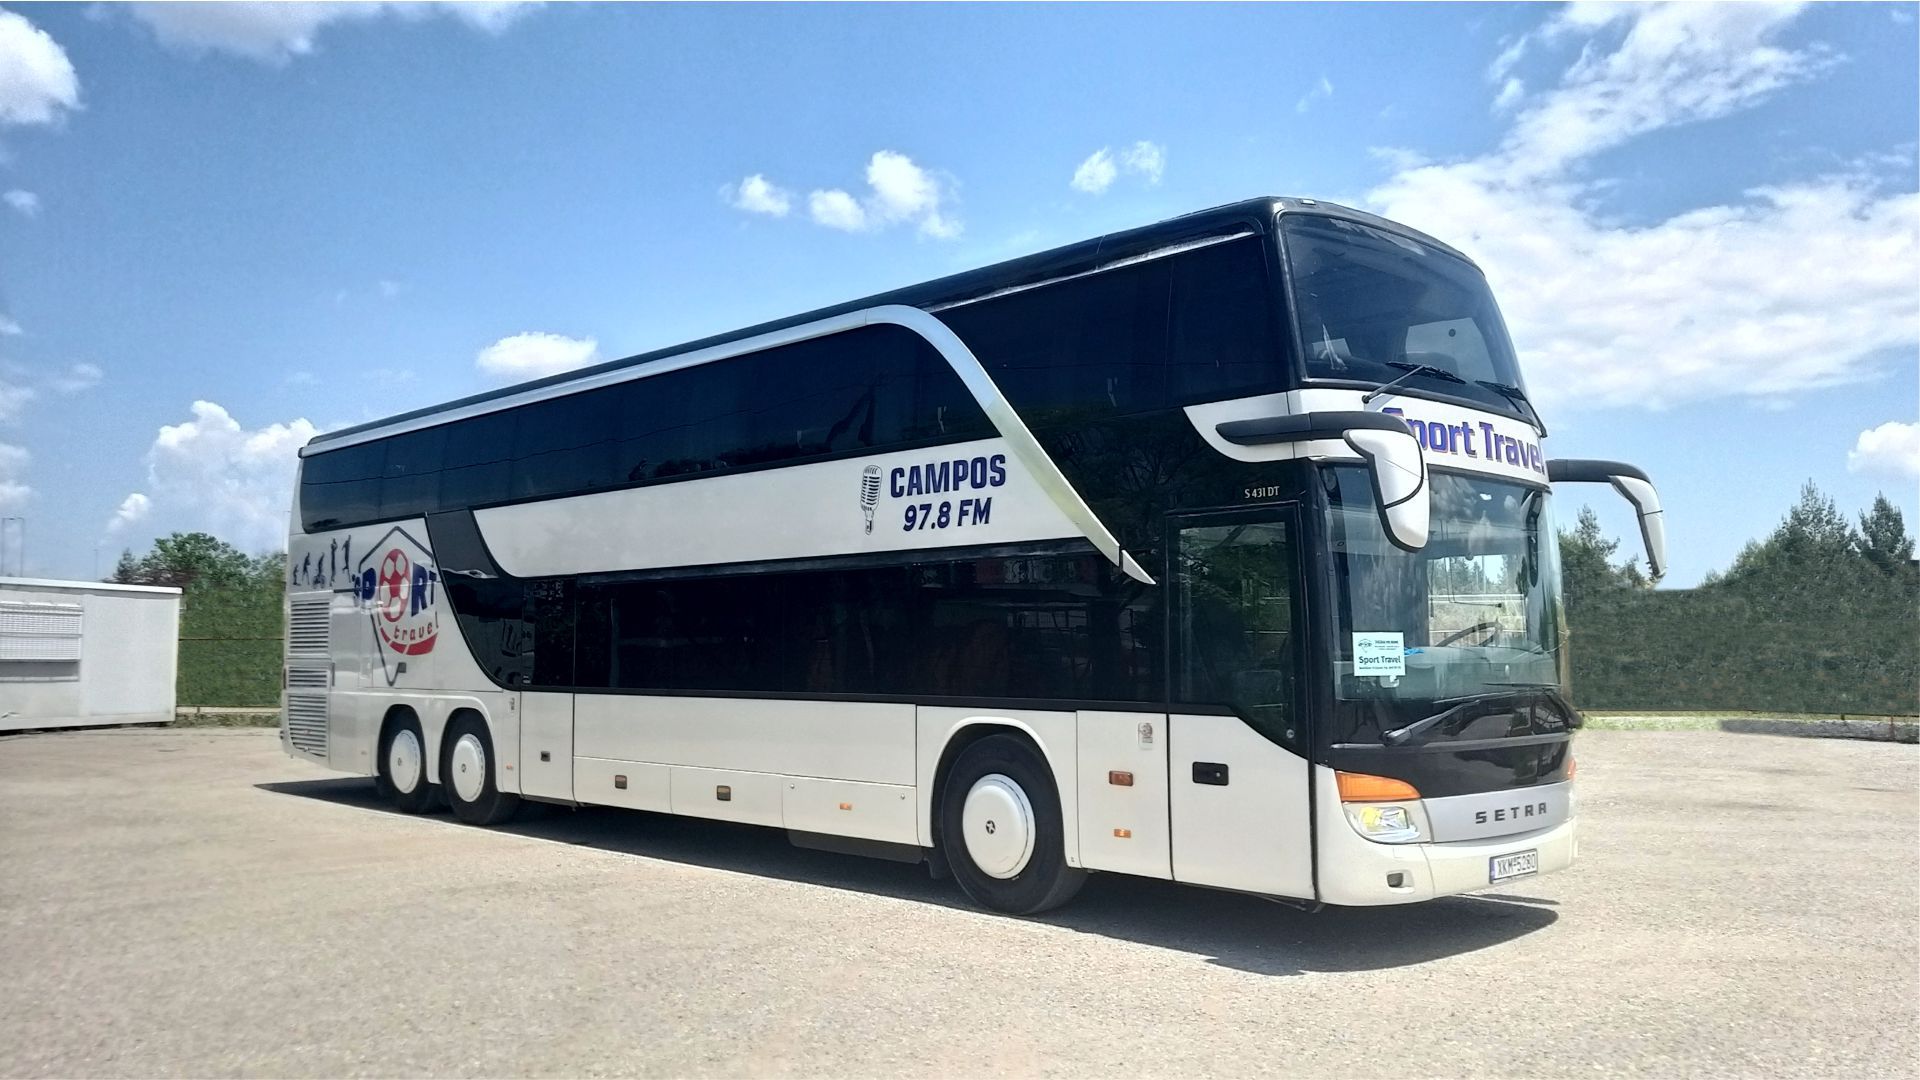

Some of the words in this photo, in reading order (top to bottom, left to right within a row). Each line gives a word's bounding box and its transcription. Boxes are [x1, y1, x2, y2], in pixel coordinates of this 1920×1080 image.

[1382, 407, 1477, 459] port
[890, 454, 1006, 498] CAMPOS
[1244, 488, 1251, 499] S
[1251, 487, 1266, 498] 431
[1267, 486, 1280, 497] DT
[903, 501, 952, 532] 97.8
[957, 497, 993, 527] FM
[1358, 656, 1380, 665] Sport
[1381, 656, 1401, 664] Travel
[1475, 802, 1547, 824] SETRA
